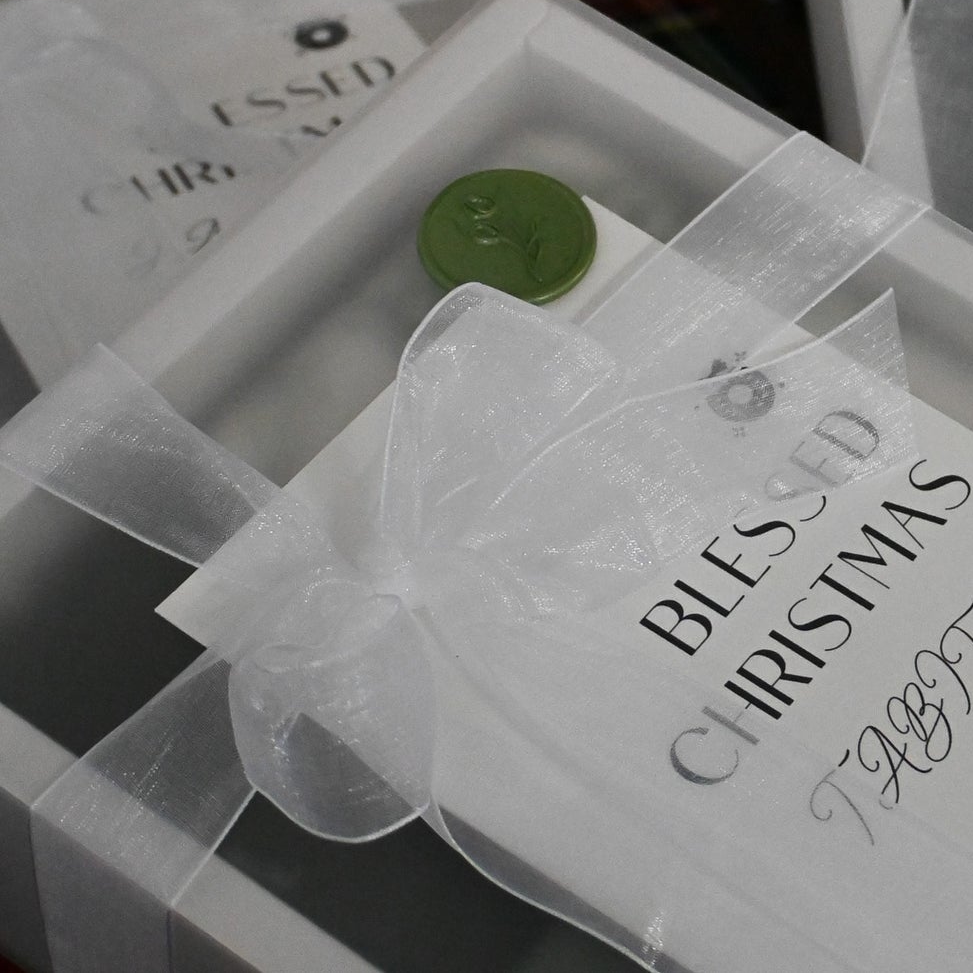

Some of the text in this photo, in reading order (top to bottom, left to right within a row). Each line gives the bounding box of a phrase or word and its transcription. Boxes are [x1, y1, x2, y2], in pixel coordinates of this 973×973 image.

[210, 55, 396, 128] ESSED
[638, 409, 880, 657] BLESSED
[669, 458, 972, 786] CHRISTMAS
